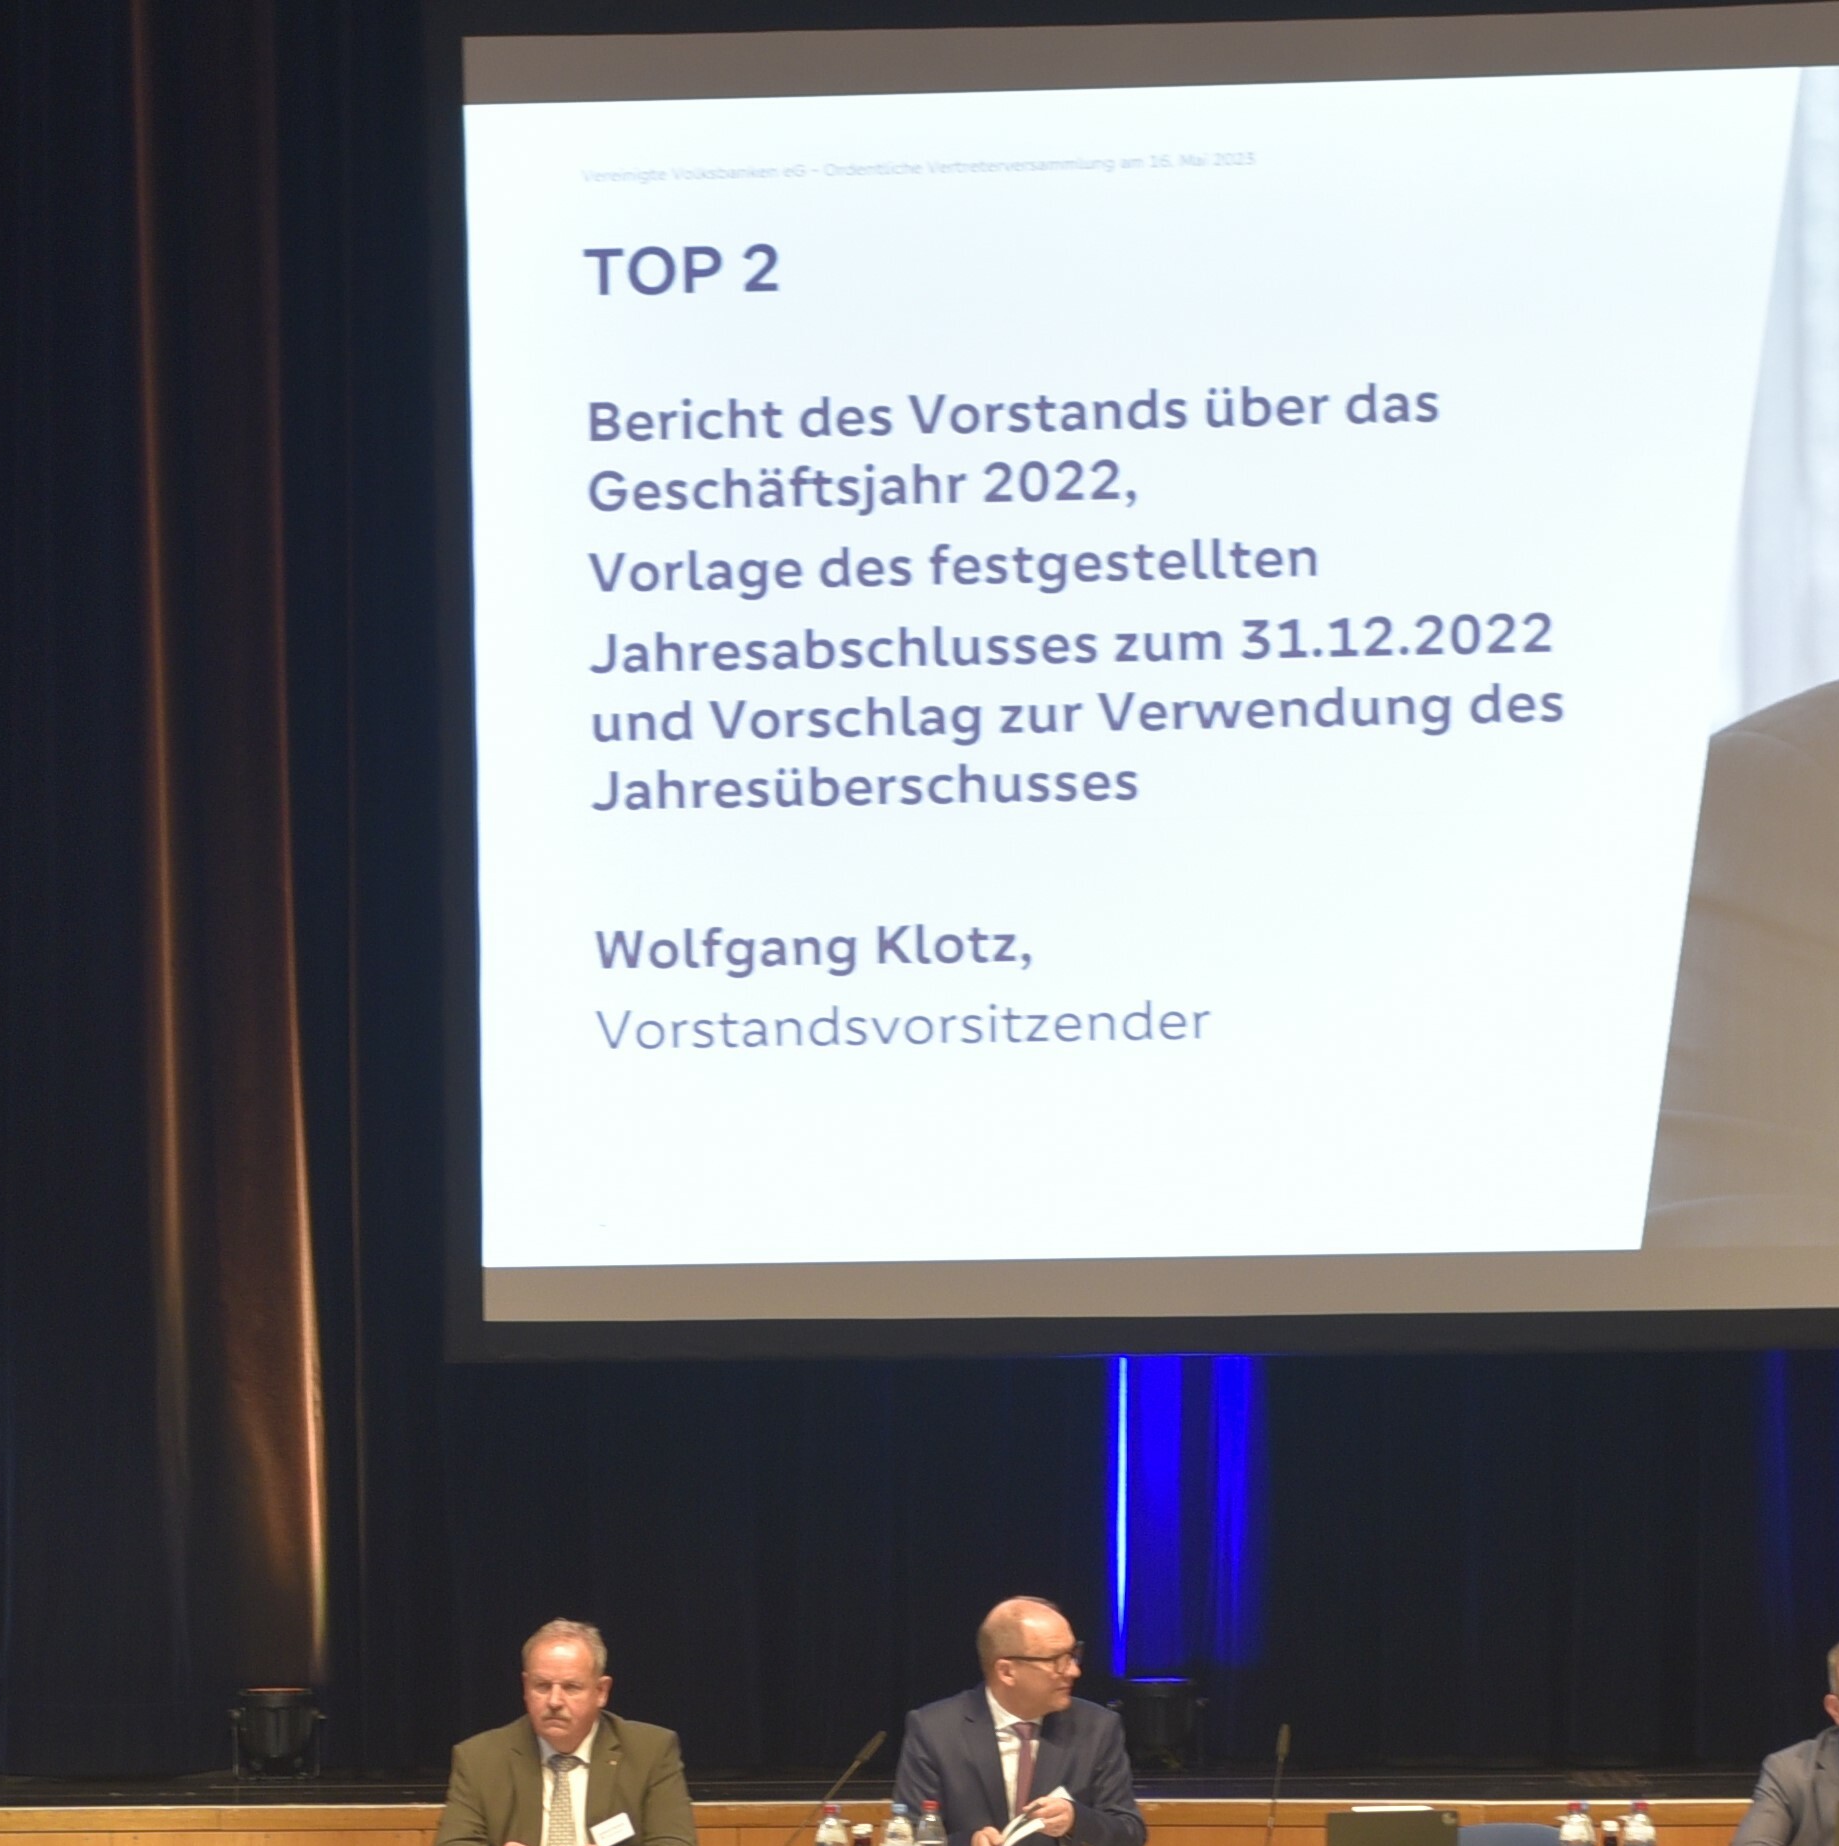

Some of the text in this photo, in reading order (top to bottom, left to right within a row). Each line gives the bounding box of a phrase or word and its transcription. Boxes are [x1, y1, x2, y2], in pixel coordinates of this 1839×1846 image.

[1120, 157, 1145, 169] am
[583, 244, 778, 295] TOP 2
[590, 383, 1438, 441] Bericht des Vorstands über das
[589, 459, 1136, 516] Geschäftsjahr 2022,
[588, 538, 1316, 600] Vorlage des festgestellten
[590, 613, 1551, 673] Jahresabschlusses zum 31.12.2022
[593, 683, 1563, 746] und Vorschlag zur Verwendung des
[592, 763, 1137, 811] Jahresüberschusses
[596, 924, 1031, 978] Wolfgang Klotz,
[597, 999, 1210, 1049] Vorstandsvorsitzender
